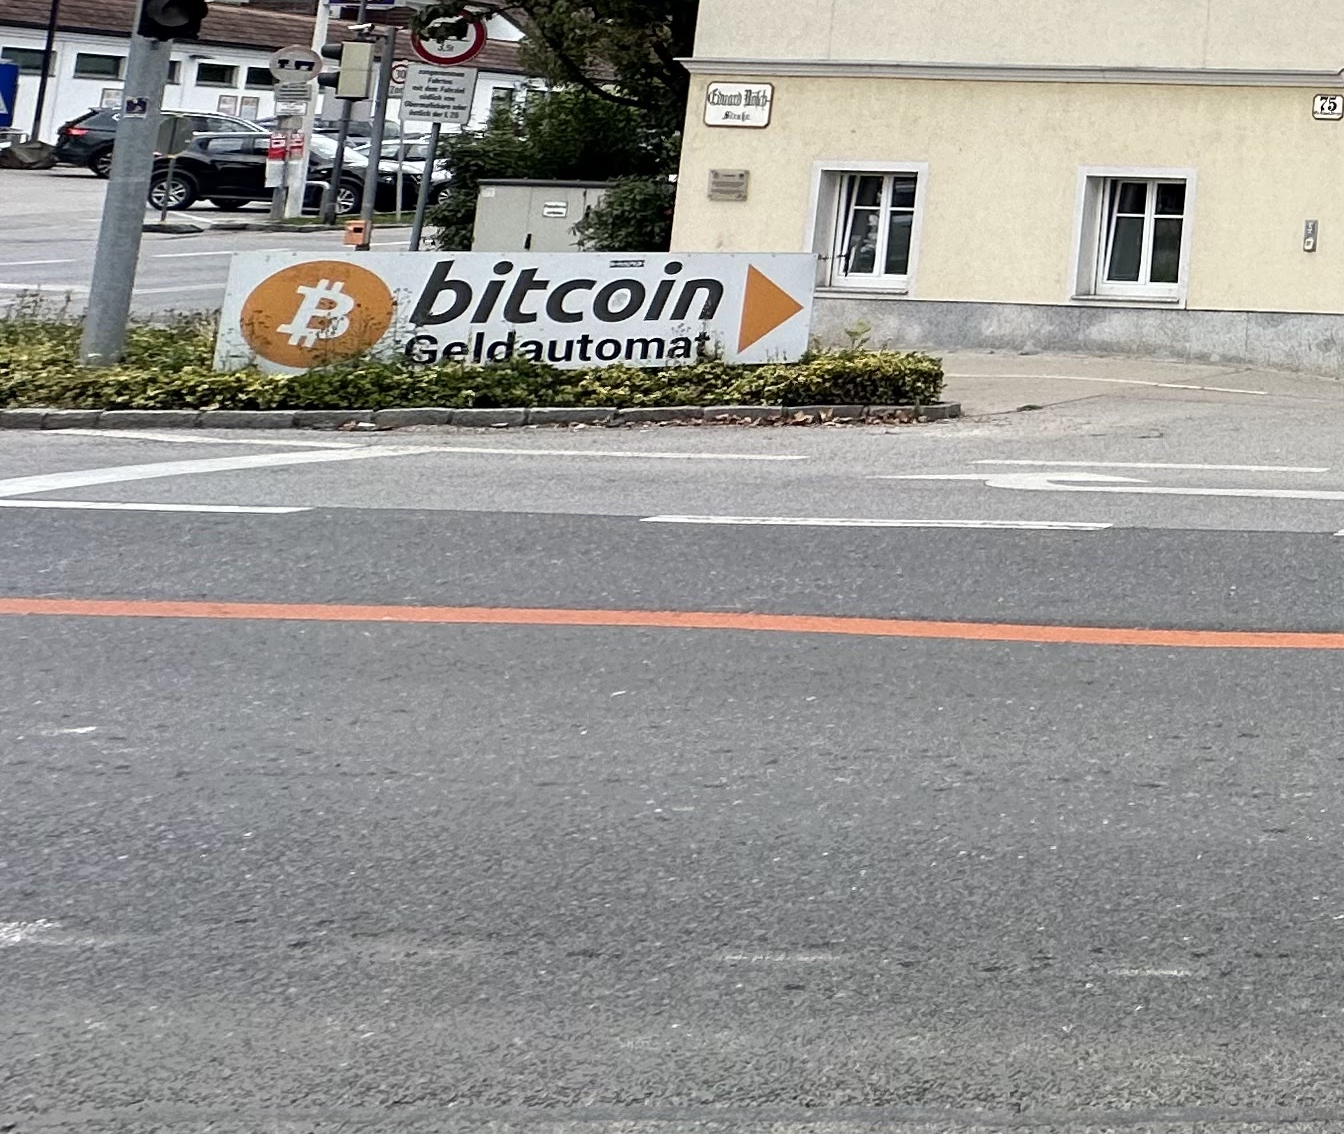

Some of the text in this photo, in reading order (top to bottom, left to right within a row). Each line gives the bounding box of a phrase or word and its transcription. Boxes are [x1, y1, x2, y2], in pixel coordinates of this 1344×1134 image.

[1319, 96, 1338, 114] 75
[408, 259, 725, 326] bitcoin
[405, 329, 711, 365] Geldautomat
